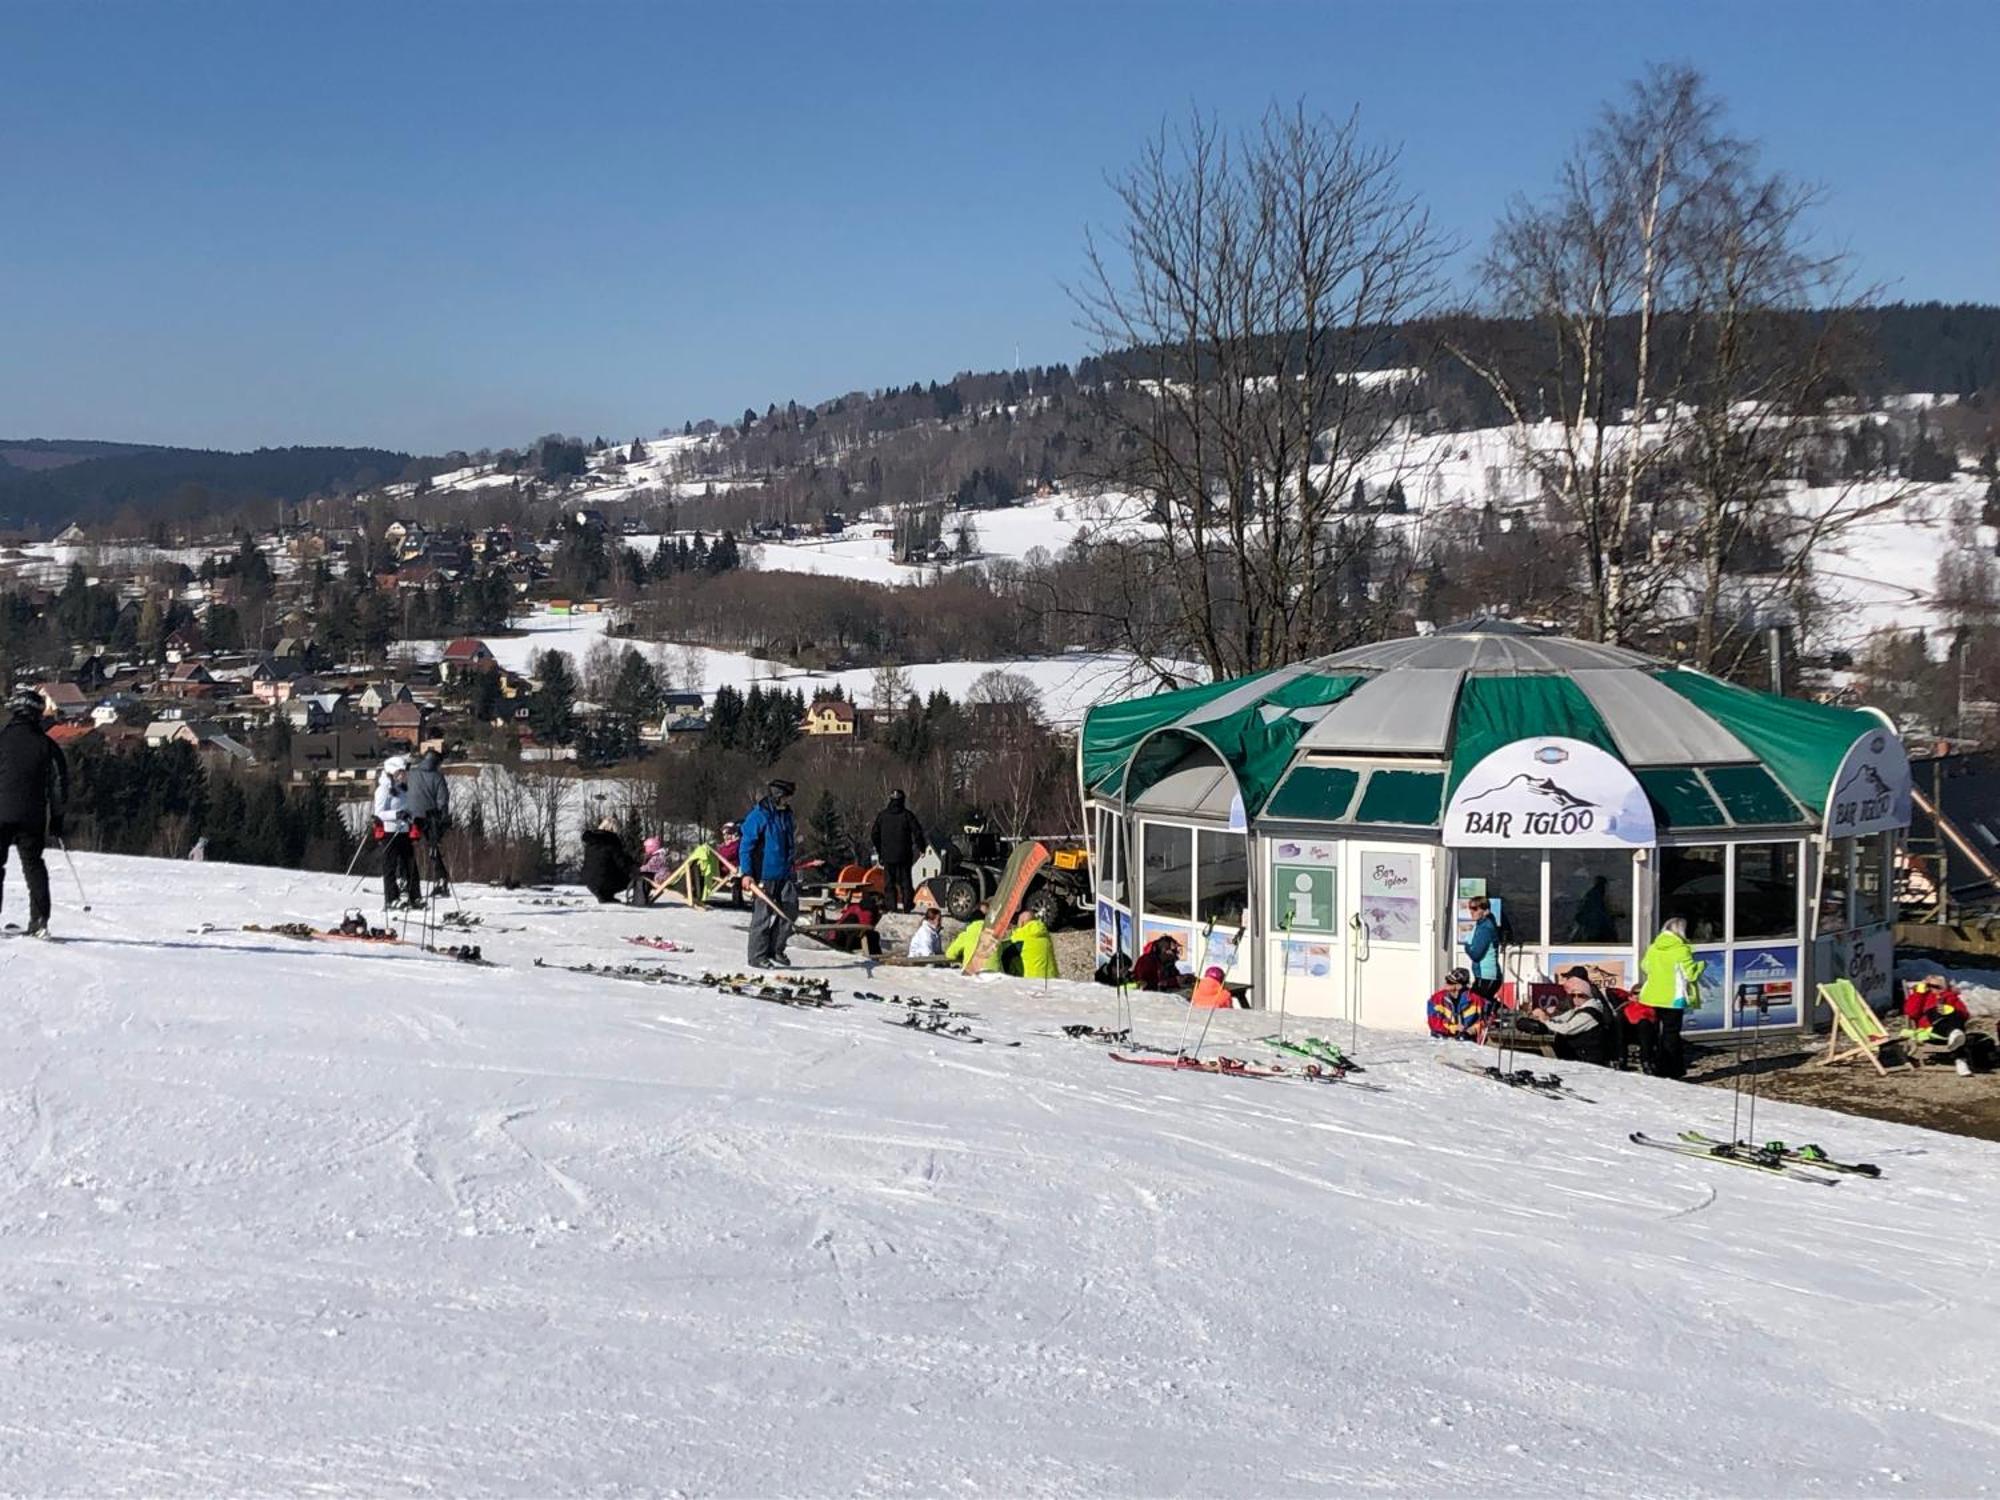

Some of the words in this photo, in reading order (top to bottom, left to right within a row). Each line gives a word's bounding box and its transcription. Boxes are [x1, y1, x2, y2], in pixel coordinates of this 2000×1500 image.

[1465, 811, 1512, 839] BAR
[1522, 809, 1594, 835] IGLOO
[1835, 801, 1856, 827] BAR
[1372, 864, 1394, 881] Bar
